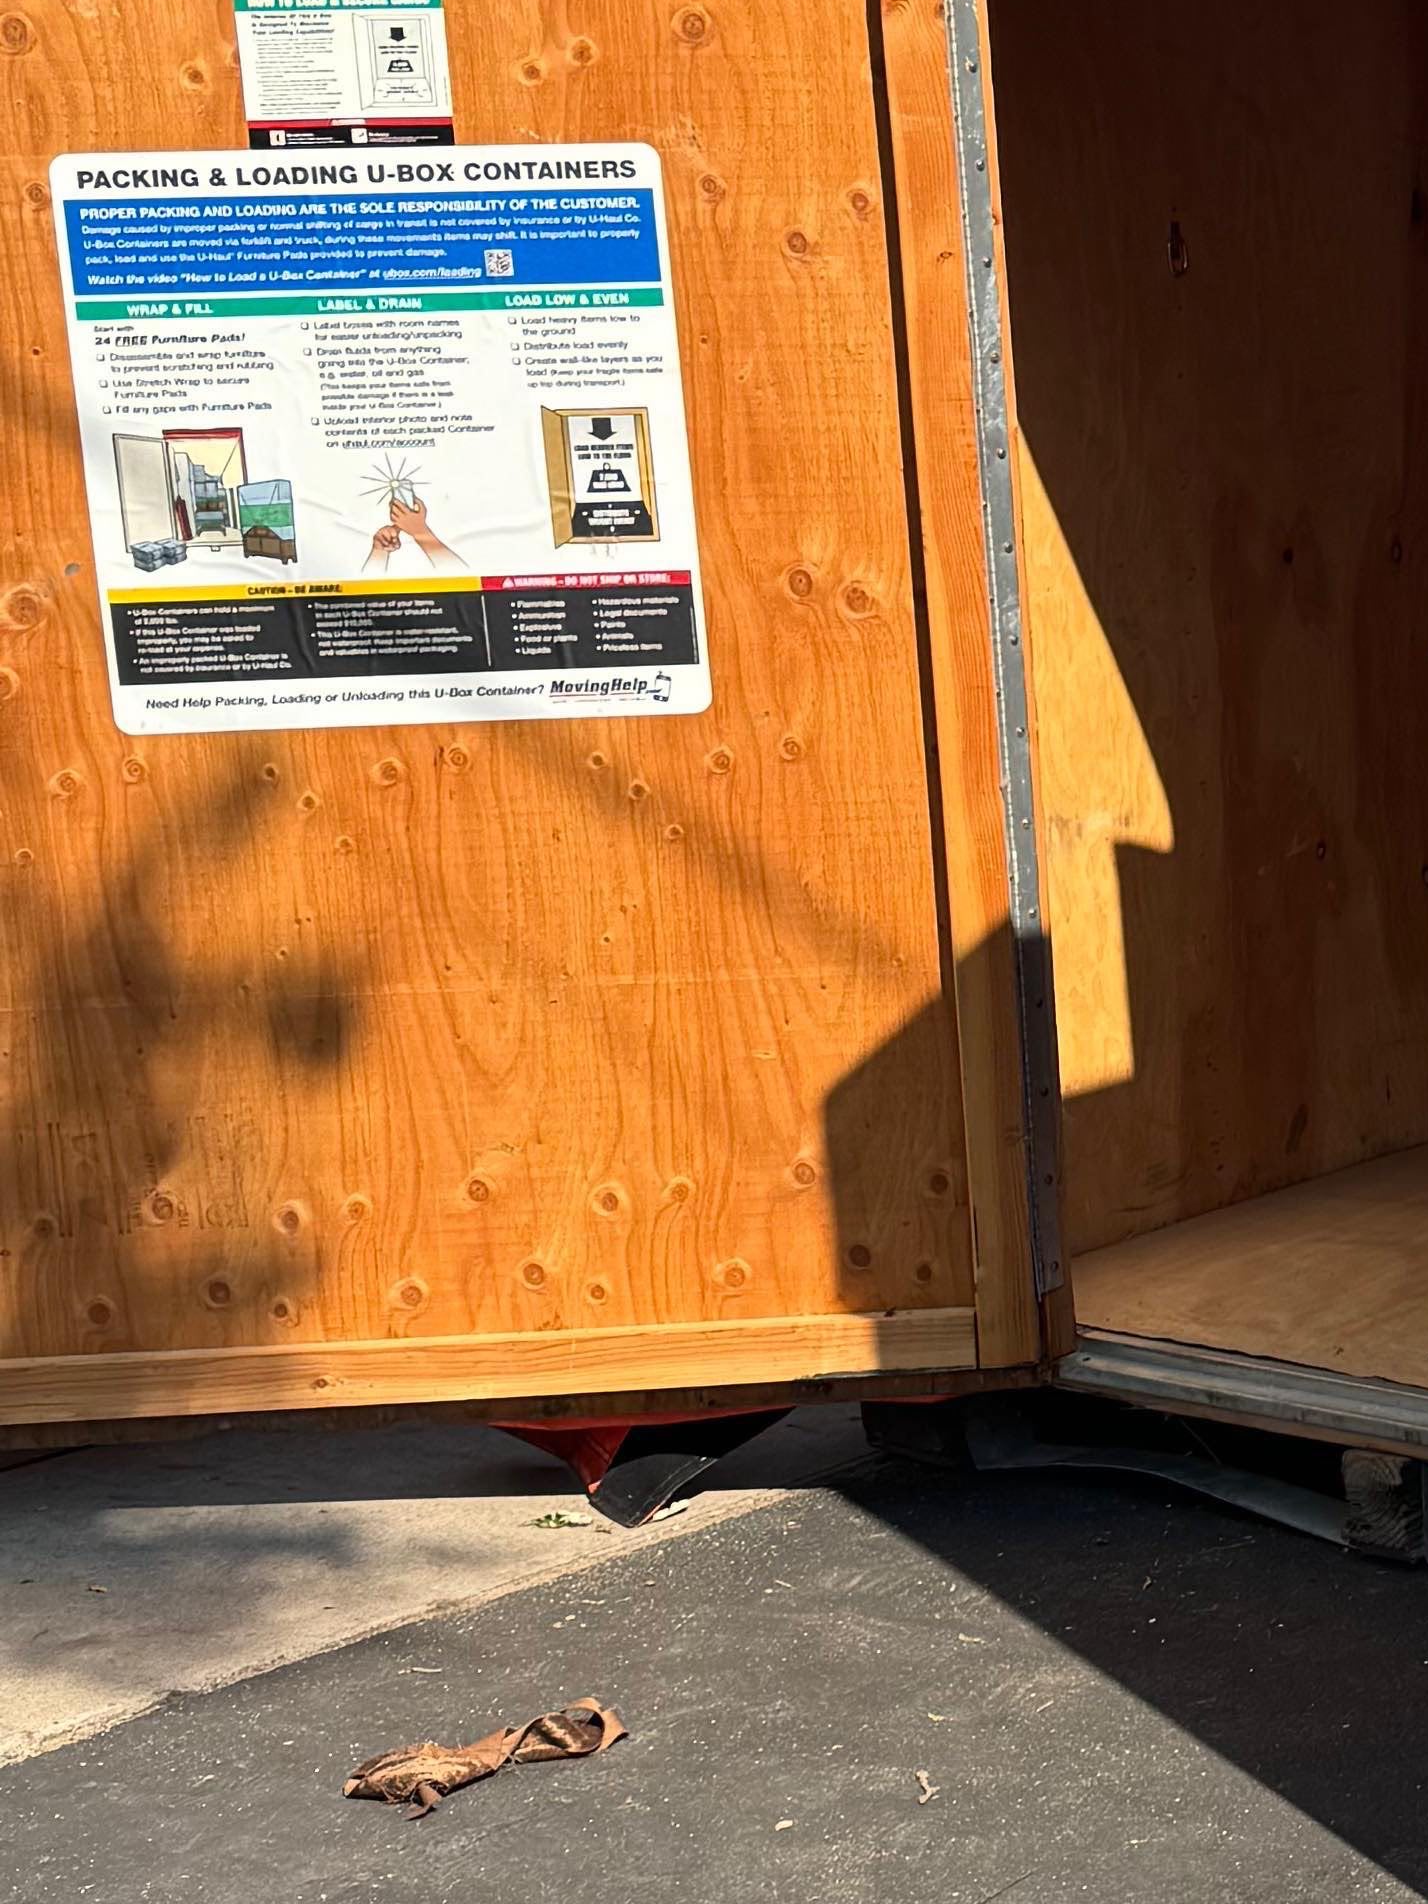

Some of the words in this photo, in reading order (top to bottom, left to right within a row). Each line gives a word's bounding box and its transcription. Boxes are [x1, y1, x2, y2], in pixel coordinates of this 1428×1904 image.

[77, 168, 198, 188] PACKING
[209, 168, 226, 186] &
[236, 165, 357, 185] LOADING
[464, 160, 636, 181] CONTAINERS
[79, 207, 136, 219] PROPER
[139, 206, 200, 218] PACKING
[203, 205, 232, 217] AND
[235, 204, 297, 216] LOADING
[299, 203, 327, 214] ARE
[329, 202, 356, 214] THE
[359, 201, 395, 213] SOLE
[397, 199, 506, 212] RESPONSIBILITY
[509, 198, 527, 210] OF
[530, 198, 557, 209] THE
[560, 196, 640, 209] CUSTOMER.
[146, 698, 179, 709] Need
[182, 697, 211, 708] Help
[215, 695, 267, 708] Packing,
[272, 693, 321, 705] Loading
[325, 694, 337, 702] or
[342, 690, 404, 703] Unloading
[409, 689, 430, 698] this
[434, 687, 472, 698] U-Box
[476, 684, 544, 696] Container?
